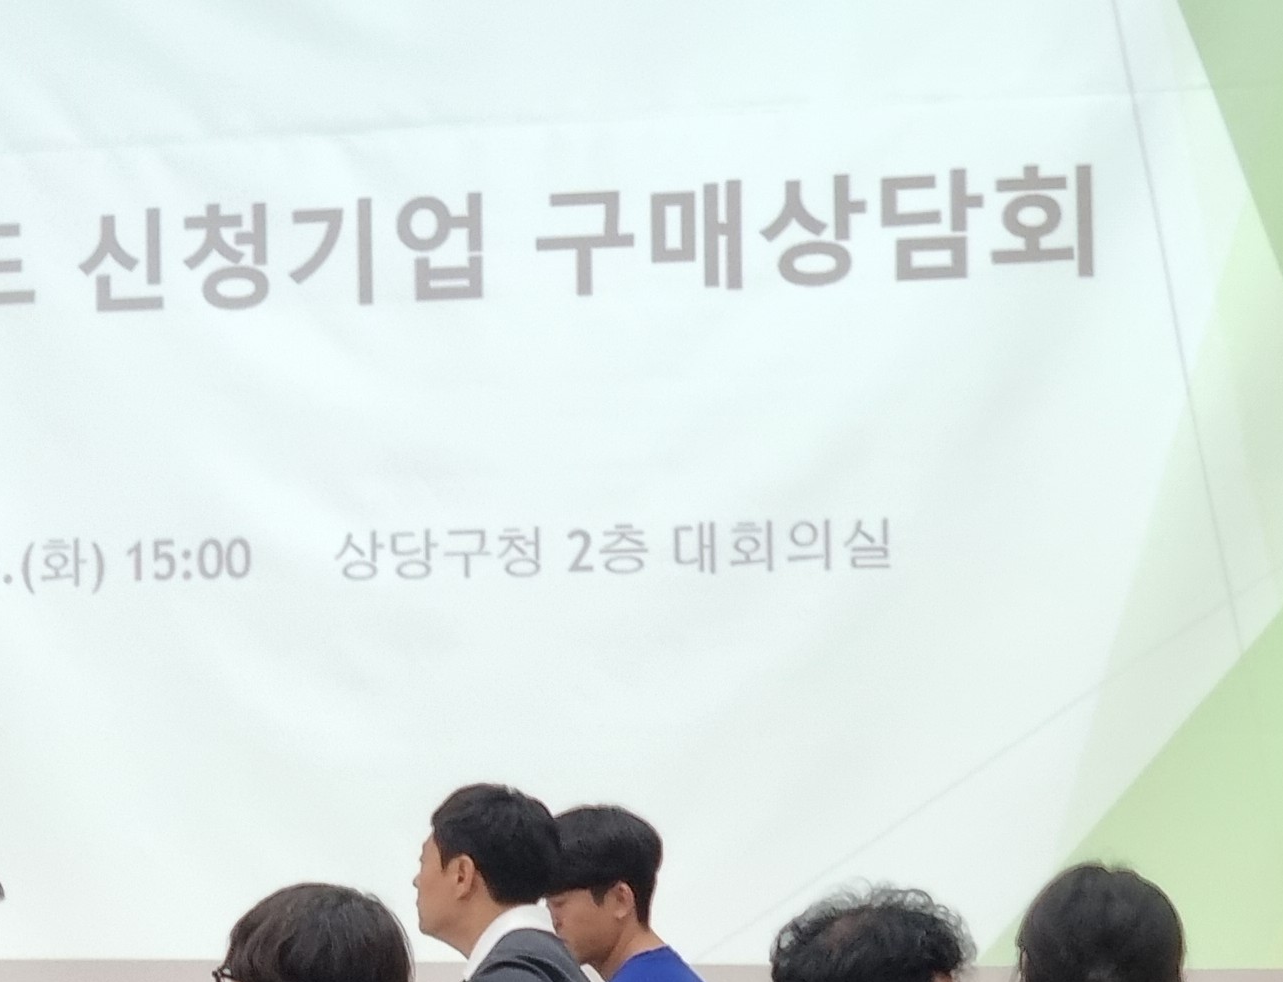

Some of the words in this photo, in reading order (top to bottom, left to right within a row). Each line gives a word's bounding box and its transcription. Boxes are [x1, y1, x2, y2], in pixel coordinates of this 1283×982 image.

[78, 191, 484, 313] 신청기업
[535, 163, 1095, 297] 구매상담회
[127, 537, 252, 581] 15:00
[336, 526, 541, 581] 상당구청
[567, 524, 648, 574] 2층
[673, 518, 890, 574] 대회의실
